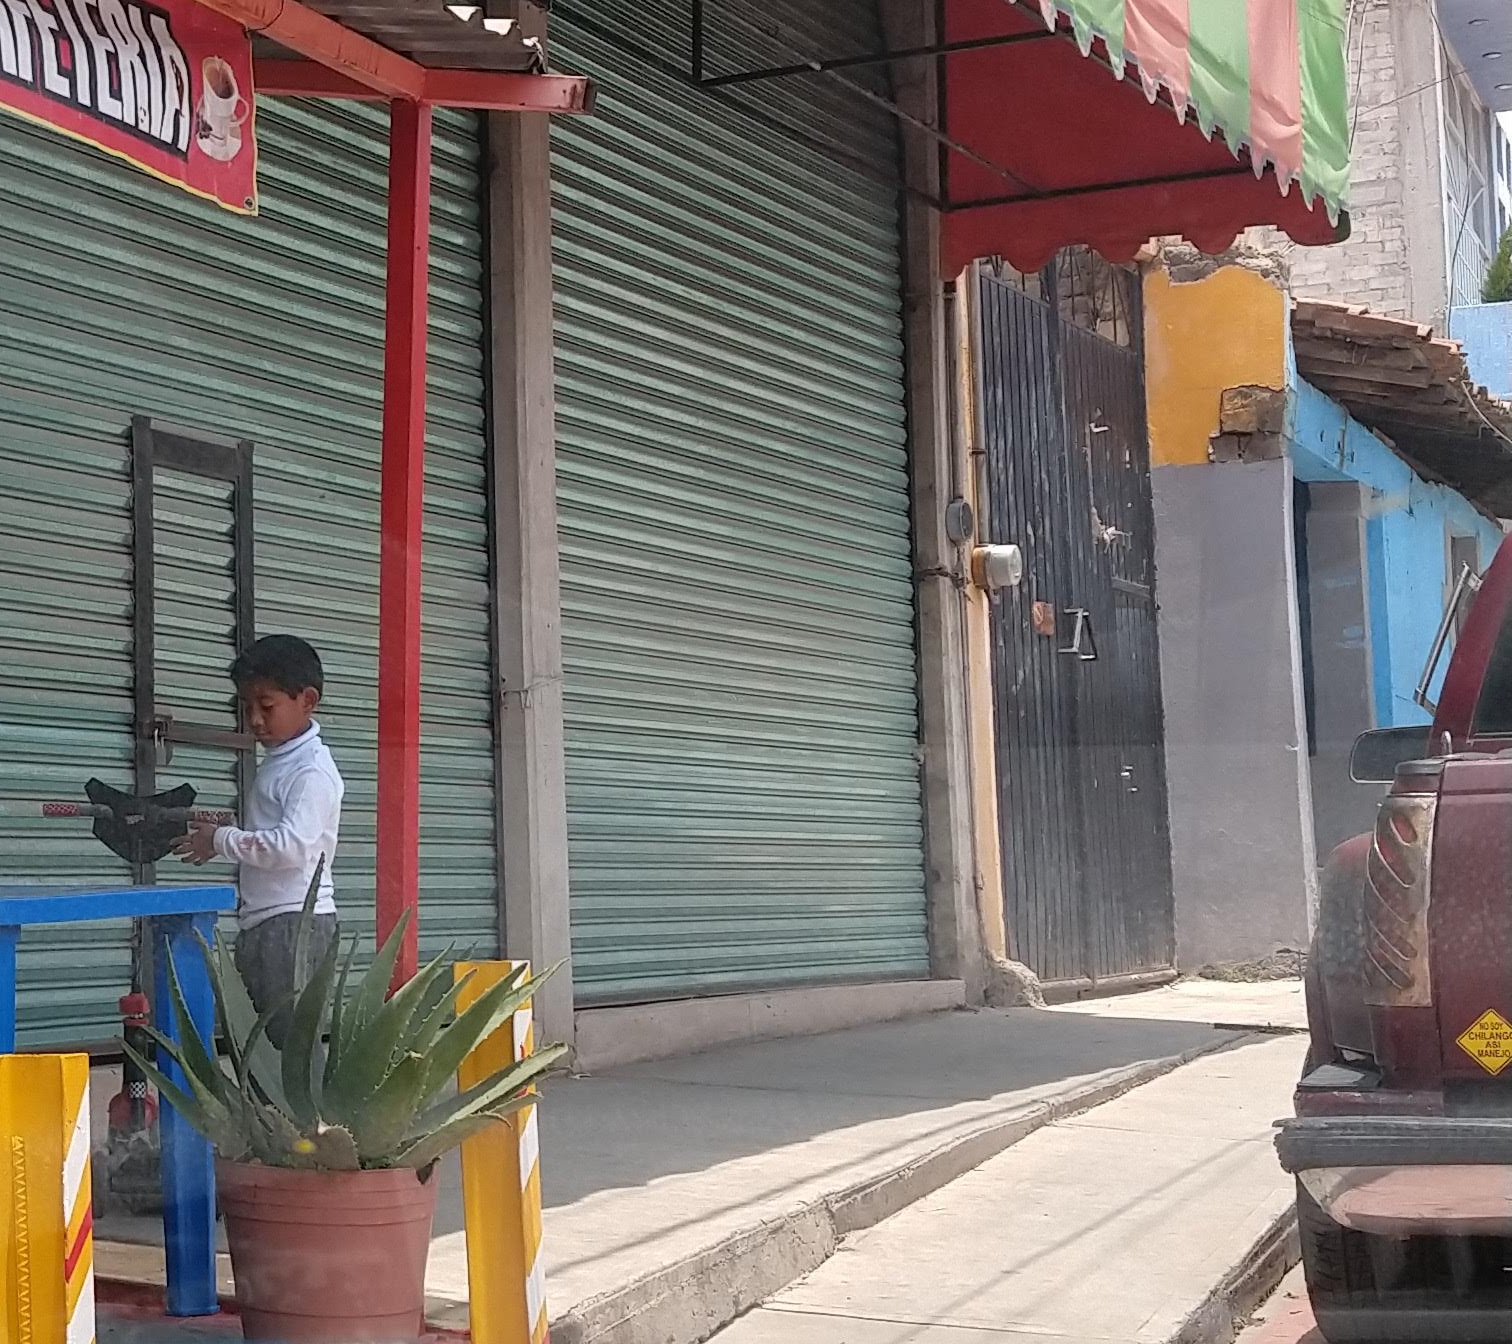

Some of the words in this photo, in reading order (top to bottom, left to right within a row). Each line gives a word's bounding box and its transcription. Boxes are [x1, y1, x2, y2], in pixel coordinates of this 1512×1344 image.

[1480, 1022, 1489, 1030] NO
[1490, 1022, 1503, 1030] SOY
[1478, 1049, 1511, 1058] MANEJO
